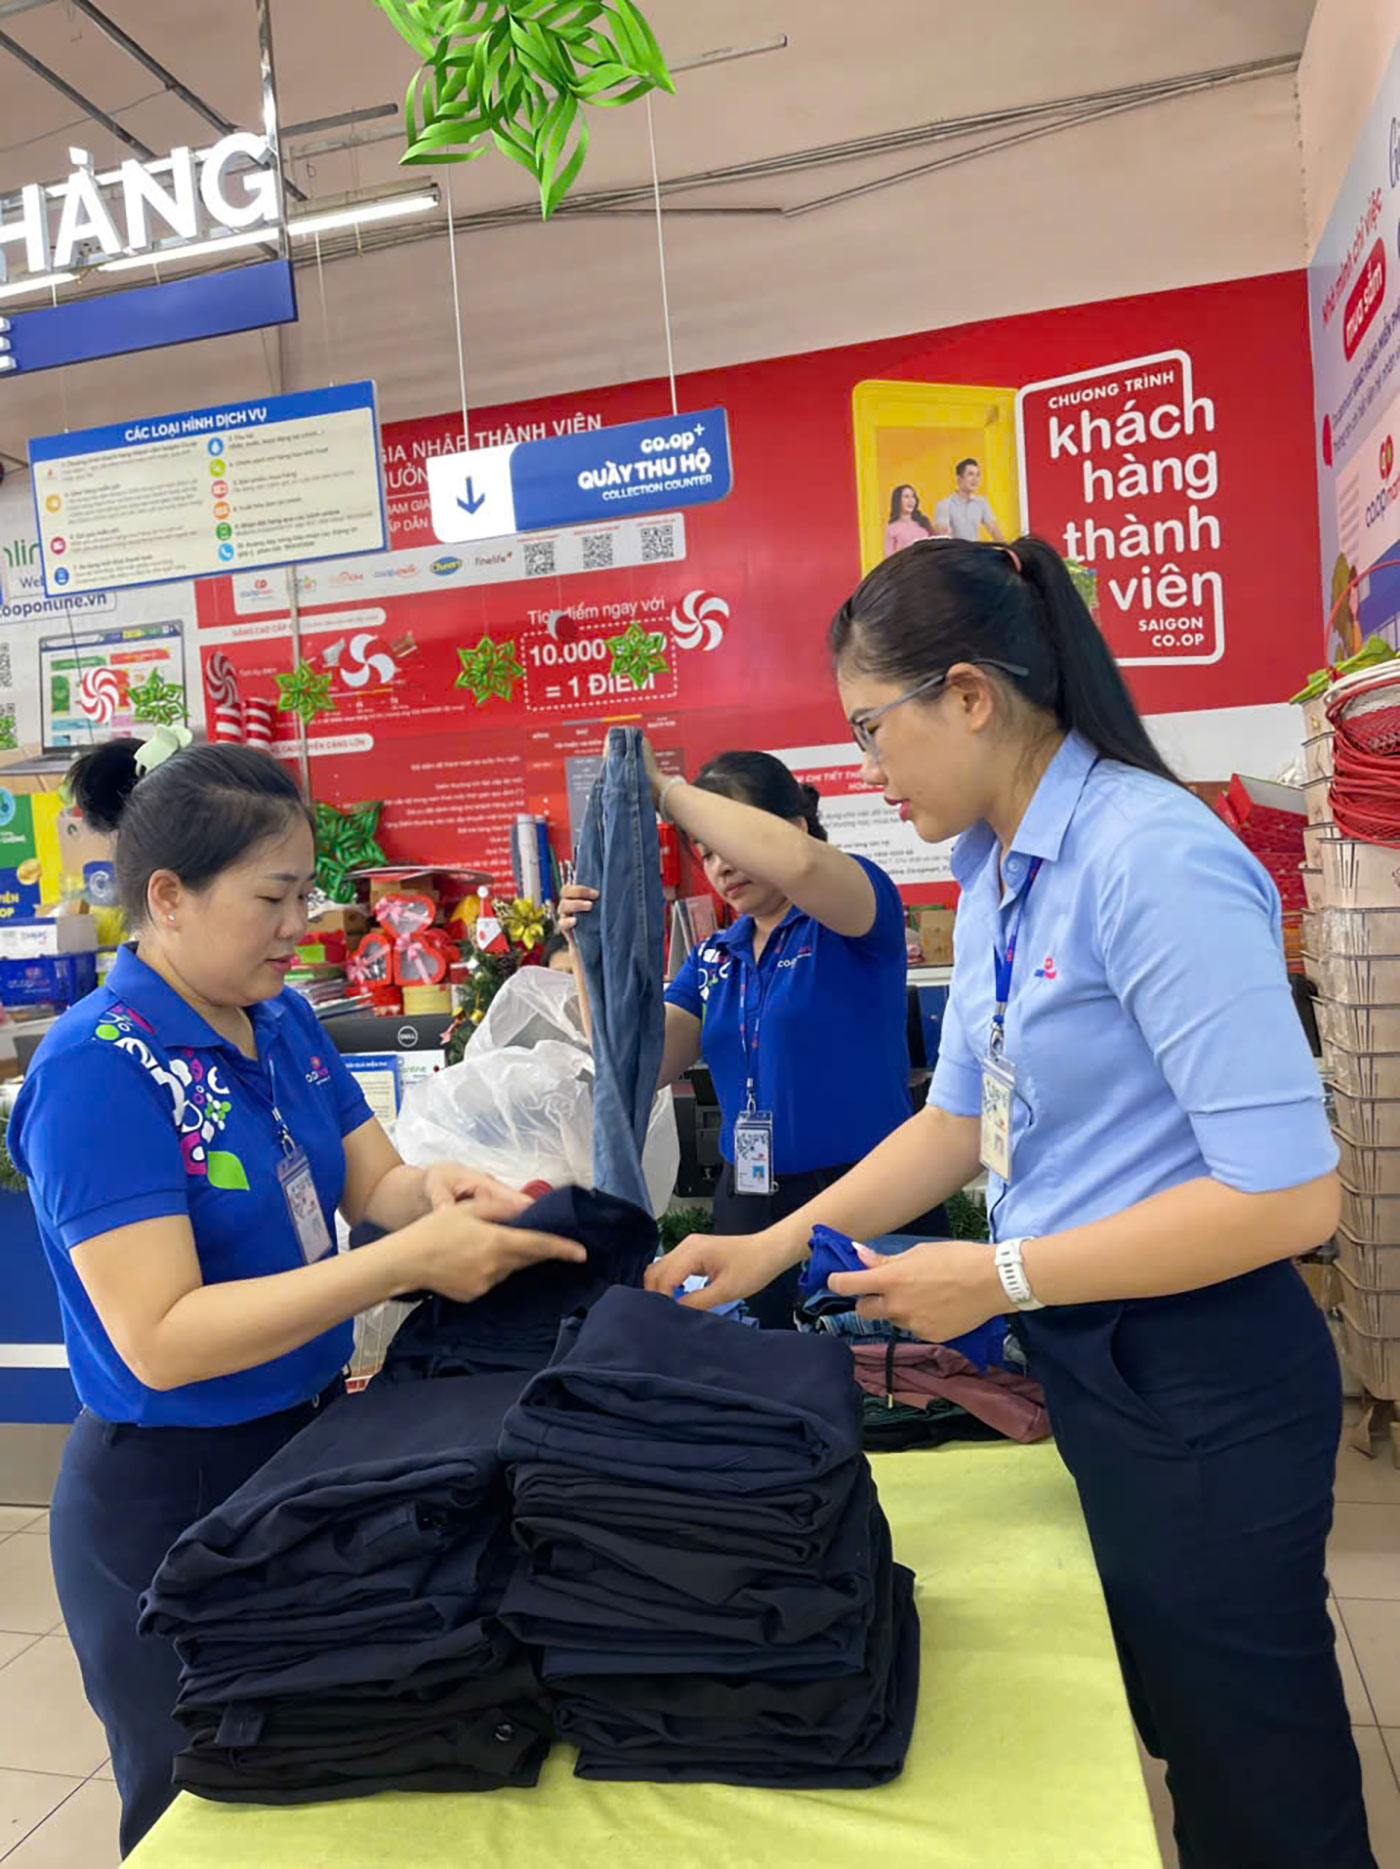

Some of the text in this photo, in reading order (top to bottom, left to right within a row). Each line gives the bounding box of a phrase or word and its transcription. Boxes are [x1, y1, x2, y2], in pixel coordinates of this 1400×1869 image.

[1047, 370, 1175, 410] CHƯƠNG TRÌNH
[125, 407, 268, 442] CÁC LOẠI HÌNH DỊCH VỤ
[475, 421, 547, 449] THÀNH
[552, 413, 603, 435] VIÊN
[1048, 396, 1216, 460] khách
[577, 449, 711, 490] QUẦY THU HỘ
[1083, 450, 1219, 504] hàng
[601, 474, 714, 502] COLLECTION COUNTER
[1062, 505, 1222, 565] thành
[1107, 563, 1224, 613] viên
[603, 601, 638, 621] ngay
[640, 597, 666, 612] với
[1138, 616, 1204, 632] SAIGON
[529, 639, 607, 668] 10.000
[1151, 634, 1205, 649] CO.OP
[568, 677, 580, 698] 1
